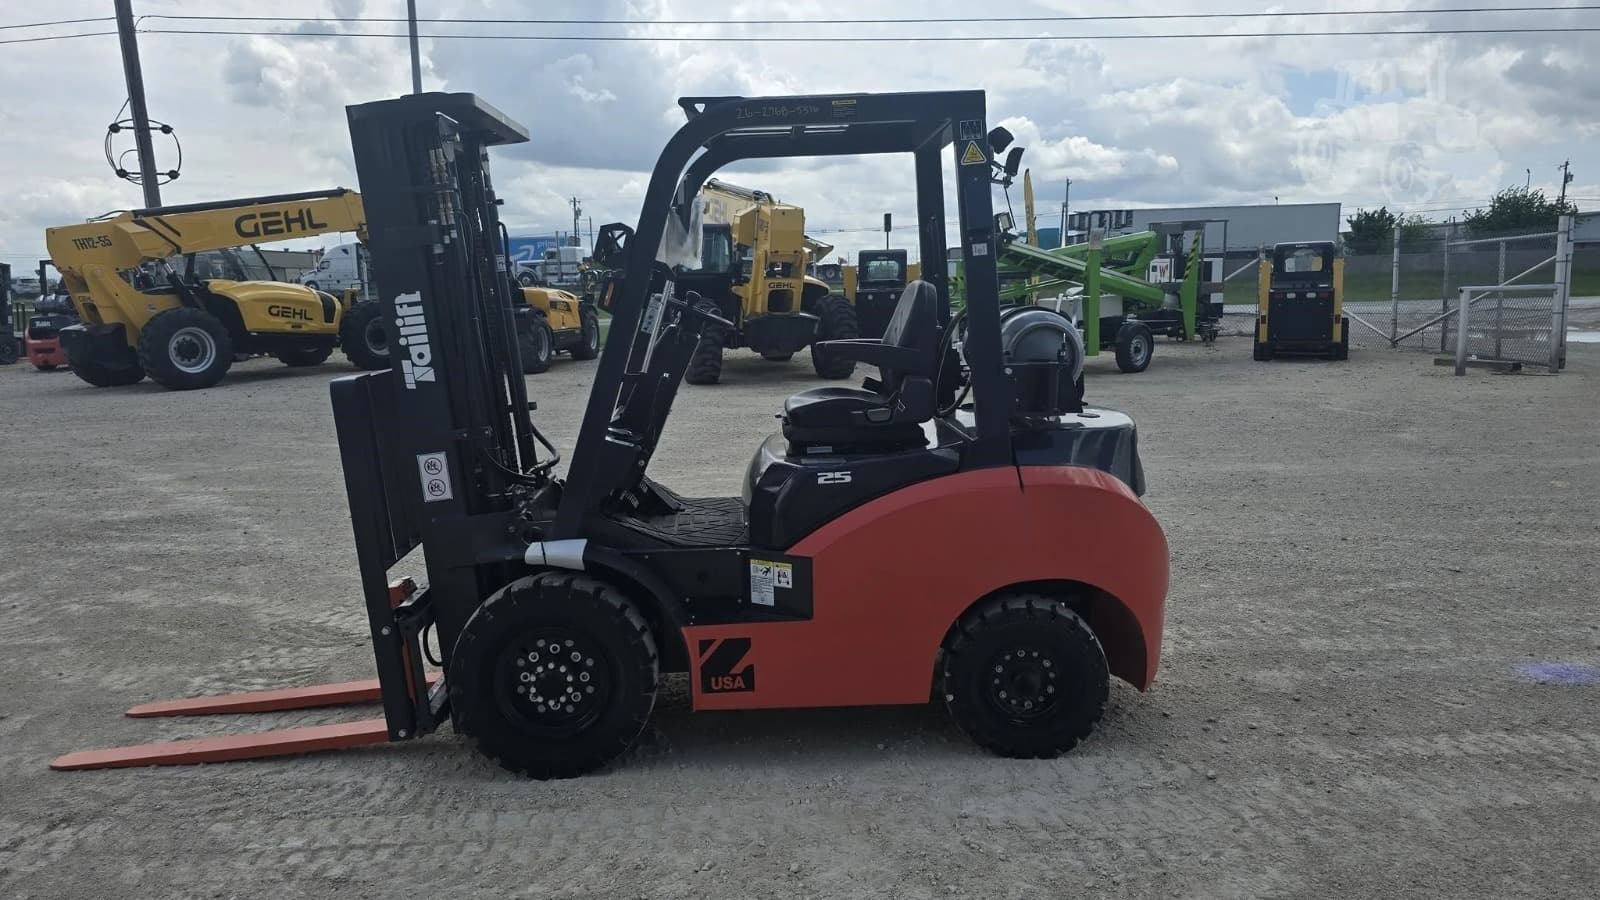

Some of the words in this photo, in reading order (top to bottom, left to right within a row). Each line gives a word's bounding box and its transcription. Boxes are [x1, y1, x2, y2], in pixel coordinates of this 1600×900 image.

[235, 208, 328, 238] GEHL
[72, 235, 112, 251] TH12-55
[268, 305, 313, 321] GEHL
[395, 290, 436, 389] Tailift
[817, 471, 852, 485] 25
[710, 676, 746, 690] USA
